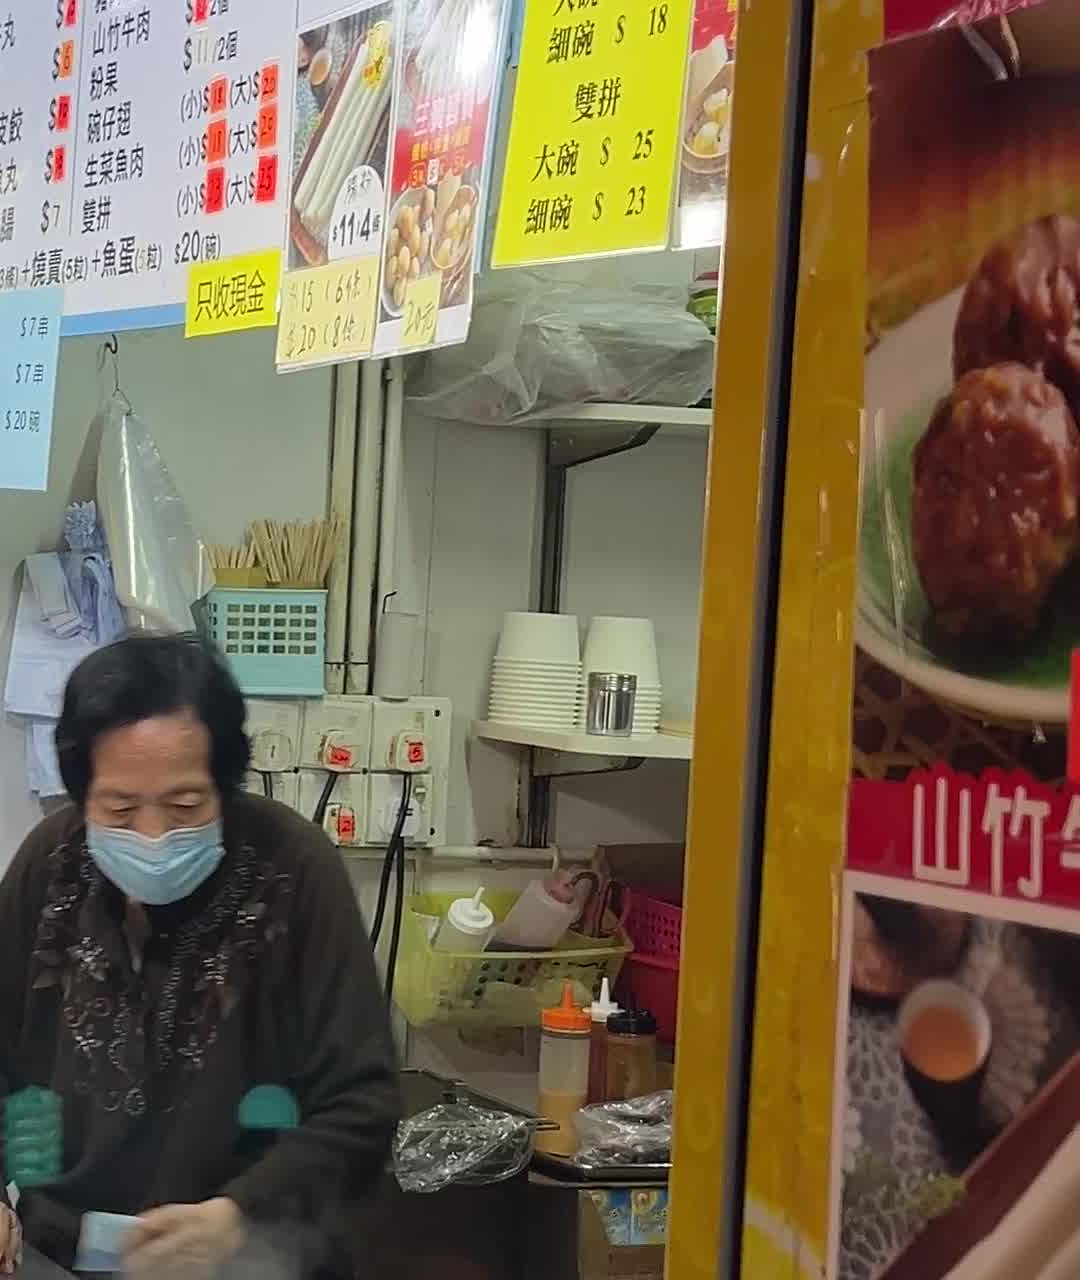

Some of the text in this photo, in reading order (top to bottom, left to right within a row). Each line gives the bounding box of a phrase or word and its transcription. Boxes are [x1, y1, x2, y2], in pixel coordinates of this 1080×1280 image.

[92, 4, 151, 58] 山竹牛肉
[547, 19, 596, 64] 細碗
[647, 2, 668, 37] 18
[89, 61, 119, 101] 粉果
[570, 76, 623, 125] 雙拼
[87, 100, 132, 145] 碗仔翅
[84, 141, 145, 189] 生菜魚肉
[530, 138, 581, 183] 大碗
[631, 128, 656, 160] 25
[524, 193, 574, 236] 細碗
[623, 184, 647, 217] 23
[194, 269, 267, 323] 只收現金
